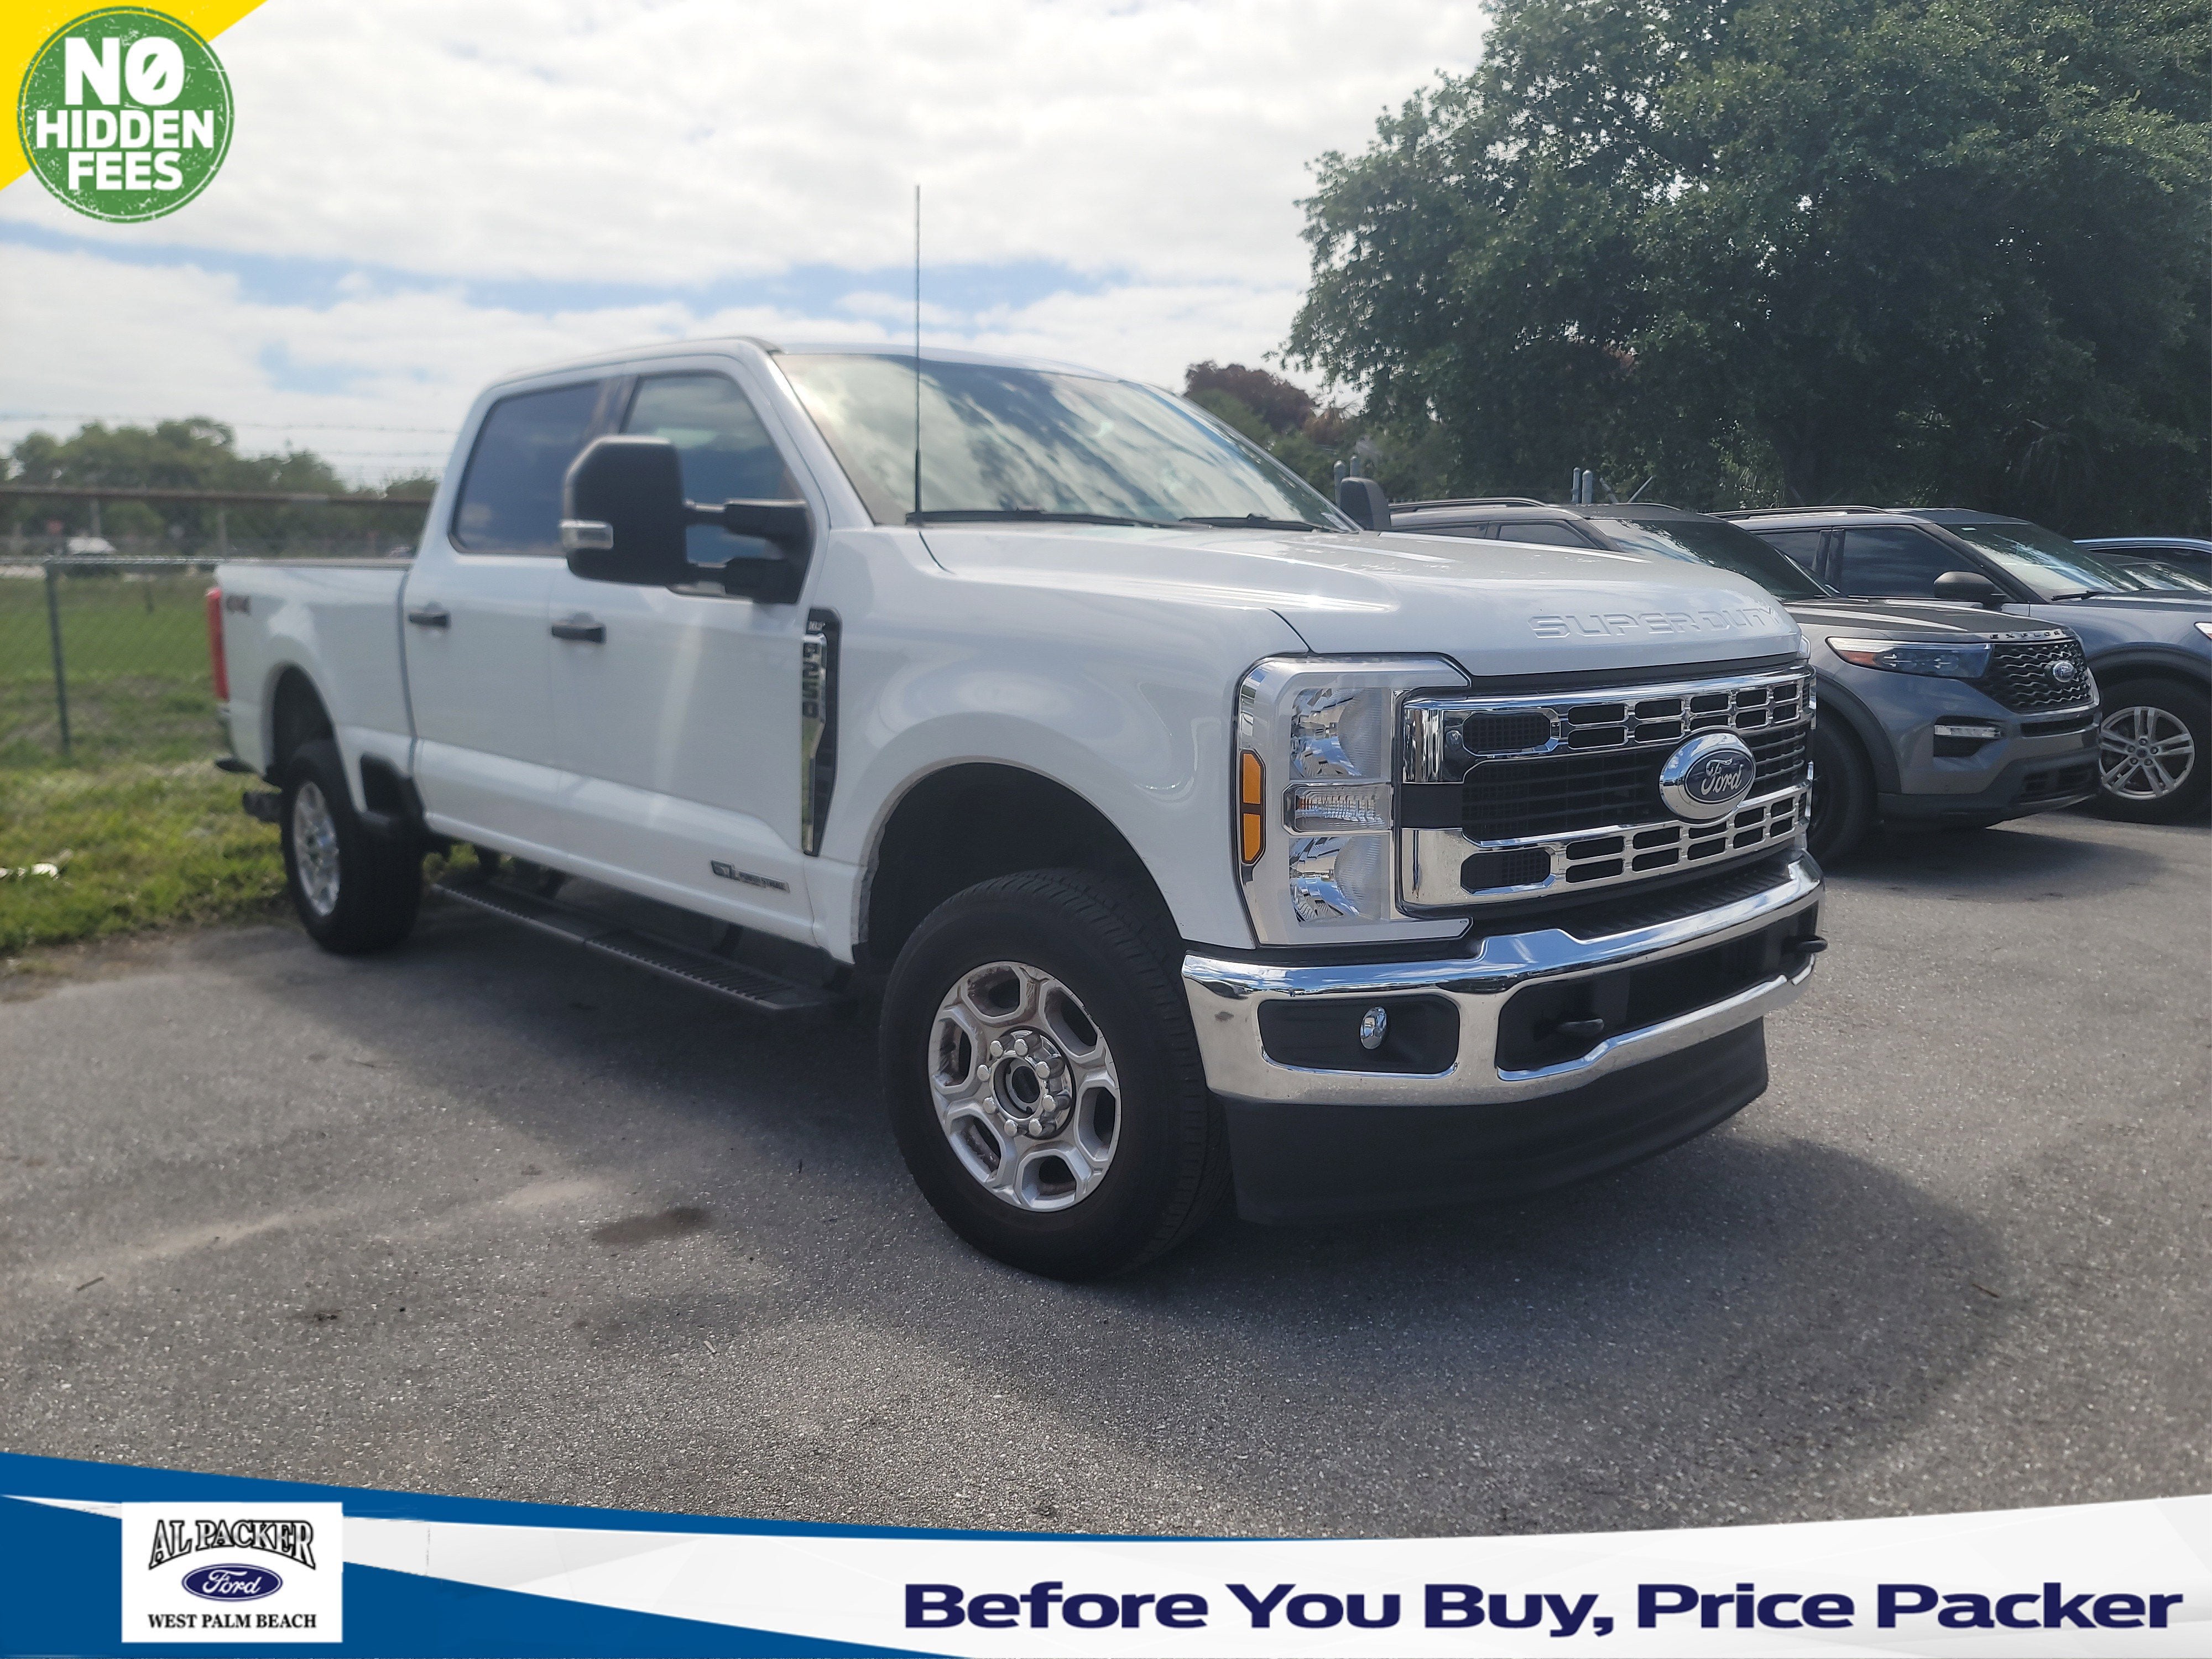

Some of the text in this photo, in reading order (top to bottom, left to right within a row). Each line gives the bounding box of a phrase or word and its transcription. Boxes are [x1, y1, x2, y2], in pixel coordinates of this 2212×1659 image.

[1527, 607, 1780, 639] SUPER DUTY
[1701, 758, 1744, 795] Ford
